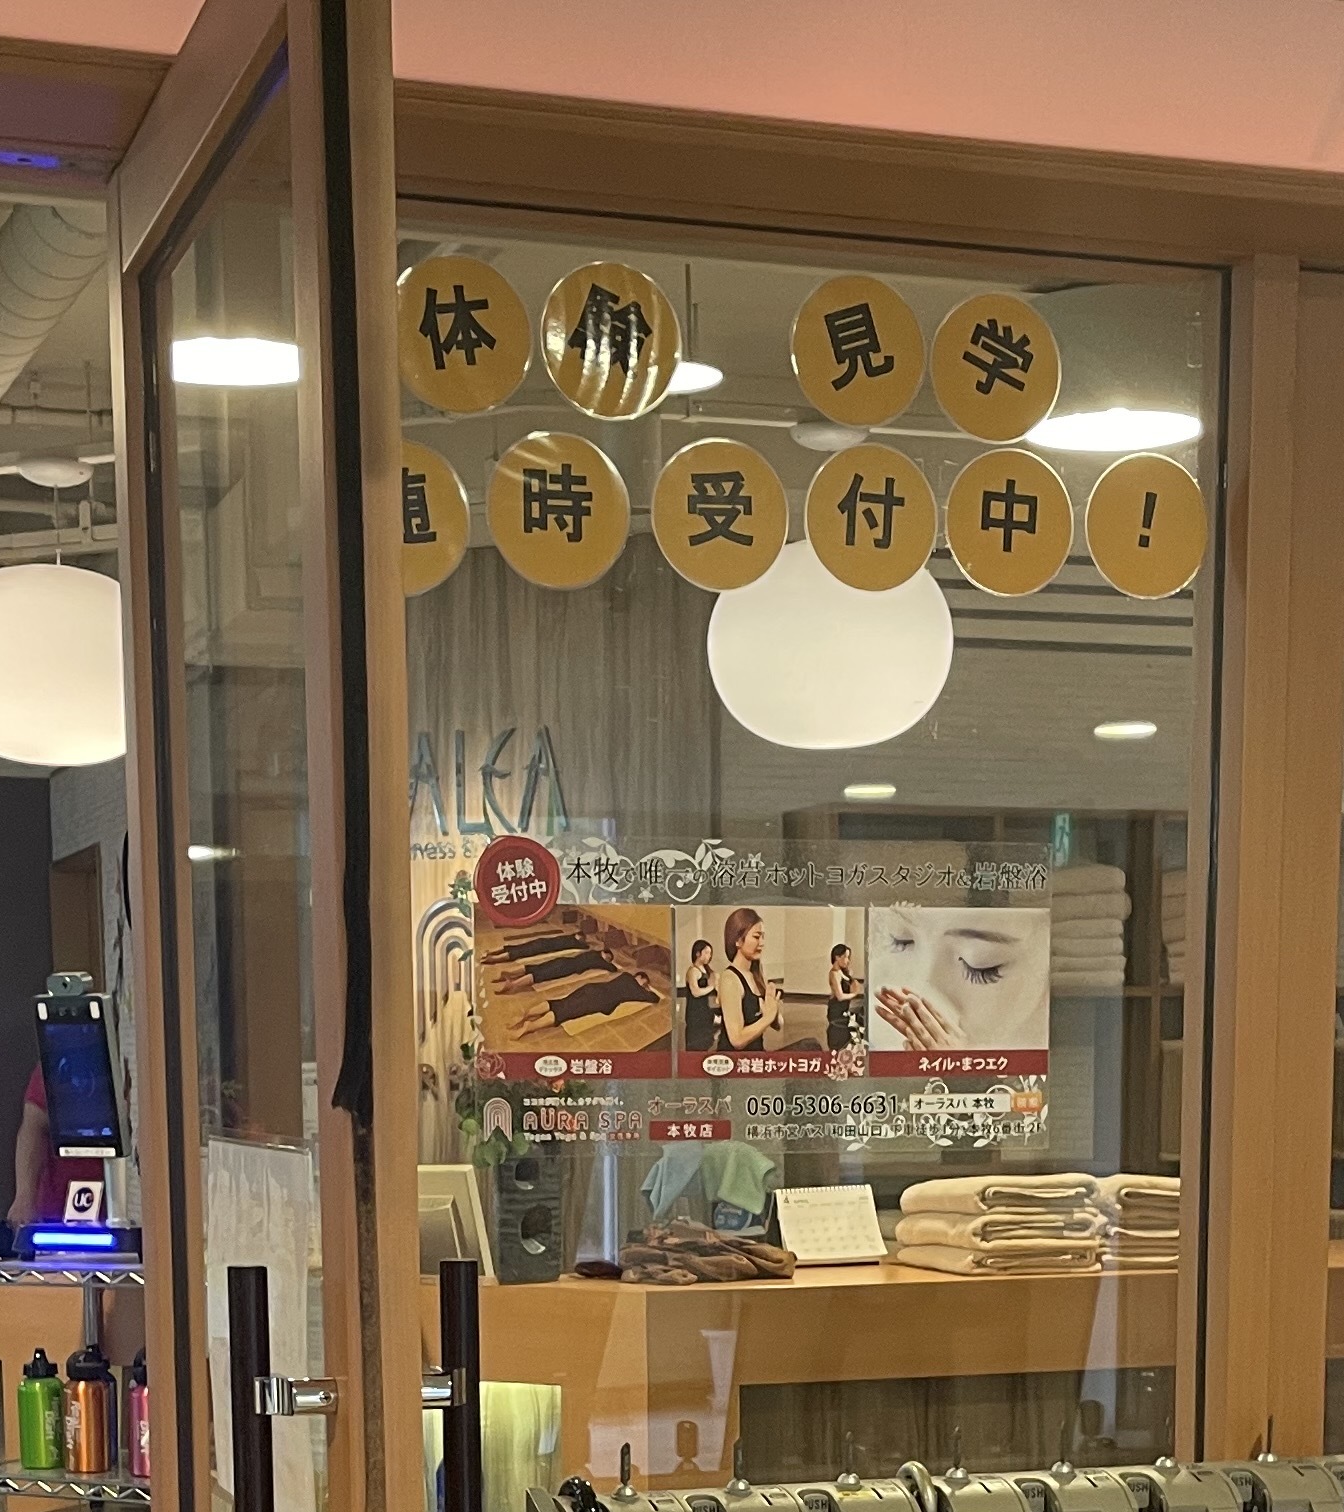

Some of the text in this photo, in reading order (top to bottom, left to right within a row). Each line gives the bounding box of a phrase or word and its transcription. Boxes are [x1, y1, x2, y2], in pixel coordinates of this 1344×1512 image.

[824, 303, 1037, 396] 見学
[495, 857, 536, 881] 体験
[491, 879, 548, 906] 受付中
[570, 1058, 614, 1075] 岩盤浴
[737, 1056, 822, 1074] 溶岩ホットヨガ
[918, 1056, 1009, 1073] ネイル・まつエク
[647, 1095, 732, 1115] オーラスパ
[747, 1095, 899, 1117] 050-5306-6631
[914, 1097, 995, 1110] オーラスパ 本牧
[523, 1107, 643, 1131] AURA SPA
[667, 1124, 714, 1139] 本牧店
